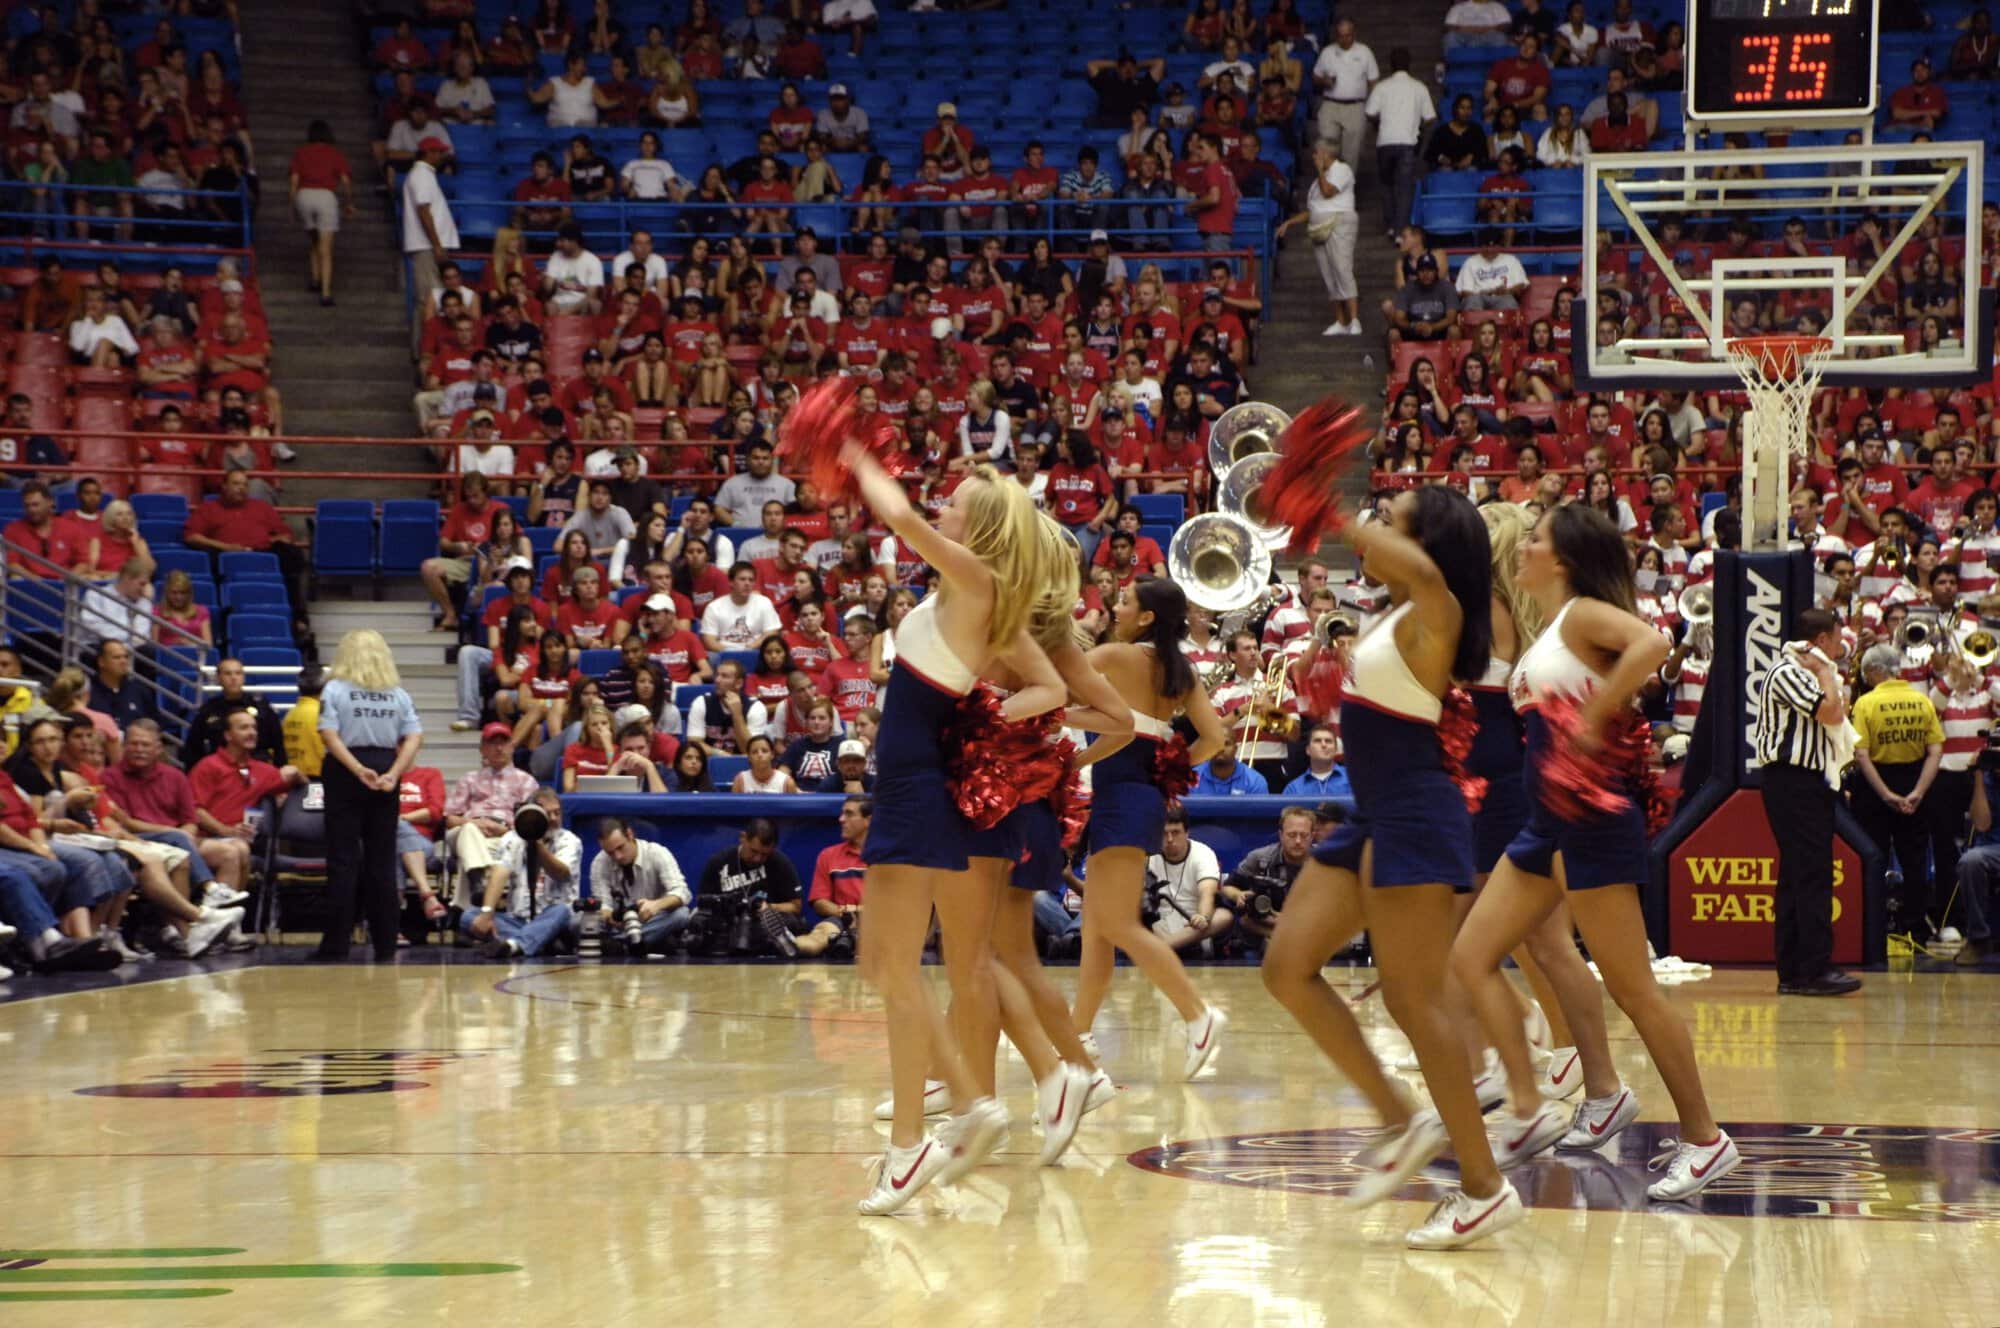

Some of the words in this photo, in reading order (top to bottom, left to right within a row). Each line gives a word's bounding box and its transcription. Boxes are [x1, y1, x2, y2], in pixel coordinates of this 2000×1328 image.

[1735, 33, 1831, 102] 35
[350, 691, 395, 702] EVENT
[353, 707, 395, 718] STAFF
[1880, 702, 1923, 712] EVENT
[1884, 716, 1923, 726] STAFF
[1691, 893, 1842, 922] FAR
